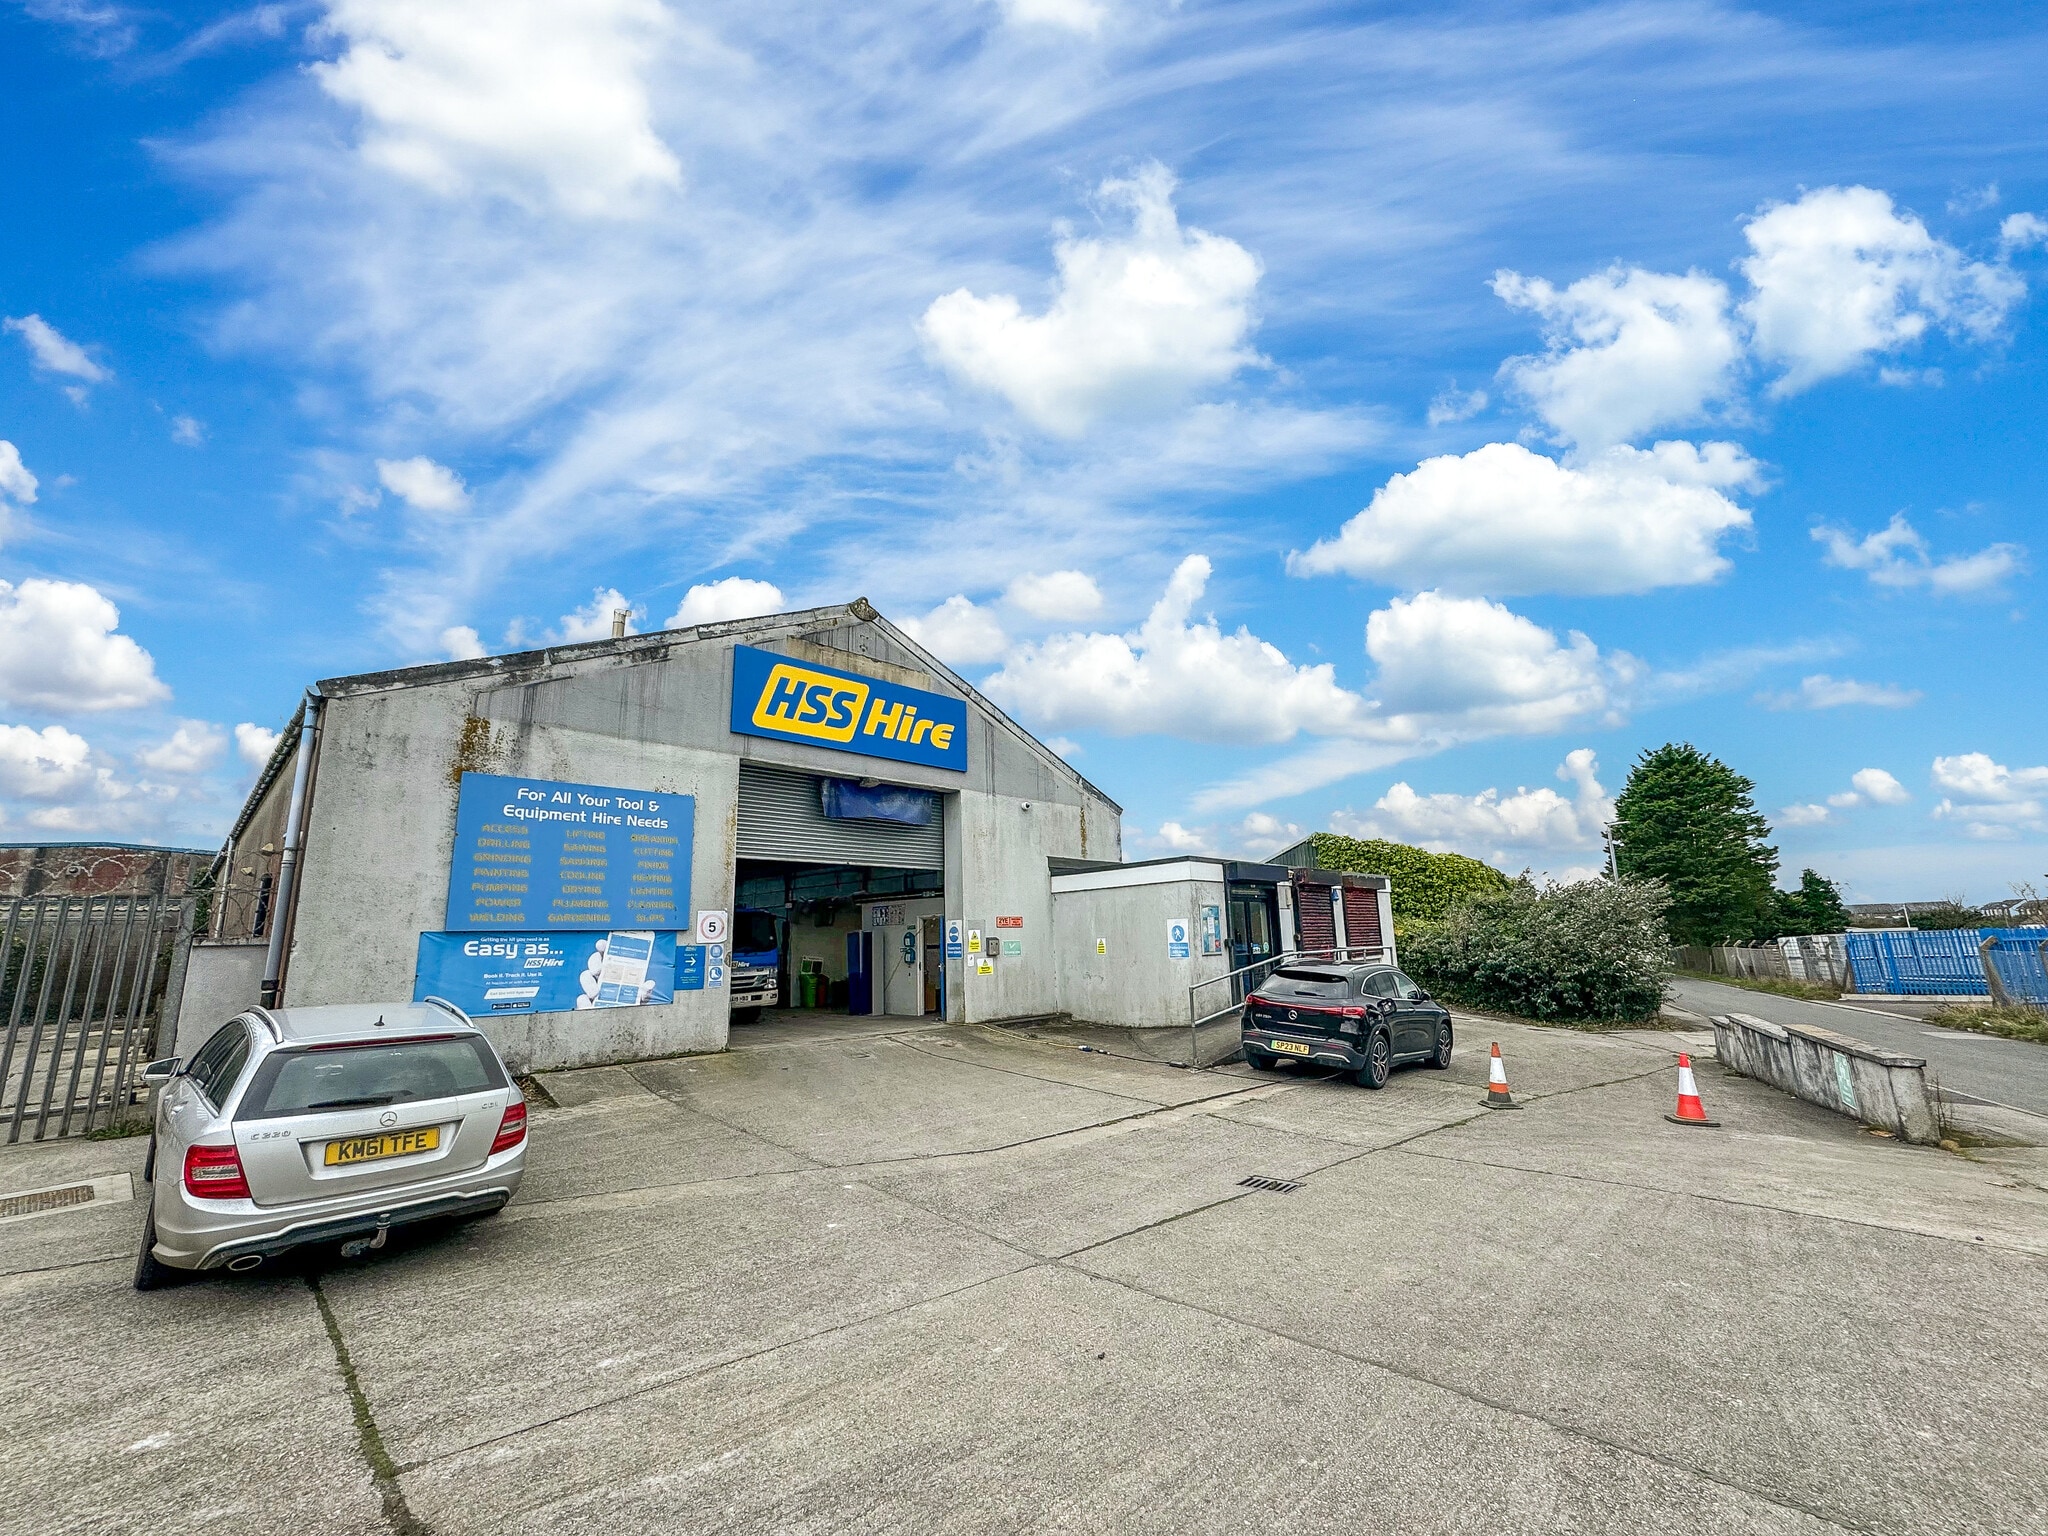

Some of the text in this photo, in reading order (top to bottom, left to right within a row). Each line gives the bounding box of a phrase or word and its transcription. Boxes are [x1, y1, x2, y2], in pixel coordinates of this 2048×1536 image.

[764, 676, 956, 750] HSS Hire
[517, 787, 660, 812] For All Your Tool &
[503, 804, 669, 830] Equipment Hire Needs
[482, 824, 529, 835] ACCESS
[477, 838, 531, 850] DRILLING
[475, 898, 522, 908] POWER
[469, 912, 526, 923] WELDING
[708, 921, 717, 933] 5
[464, 940, 564, 960] Easy as...
[526, 958, 565, 967] HSS Hire
[1275, 1041, 1294, 1051] SP23
[481, 1101, 498, 1110] CDI
[263, 1131, 291, 1139] 220
[336, 1132, 429, 1161] KM61 TFE
